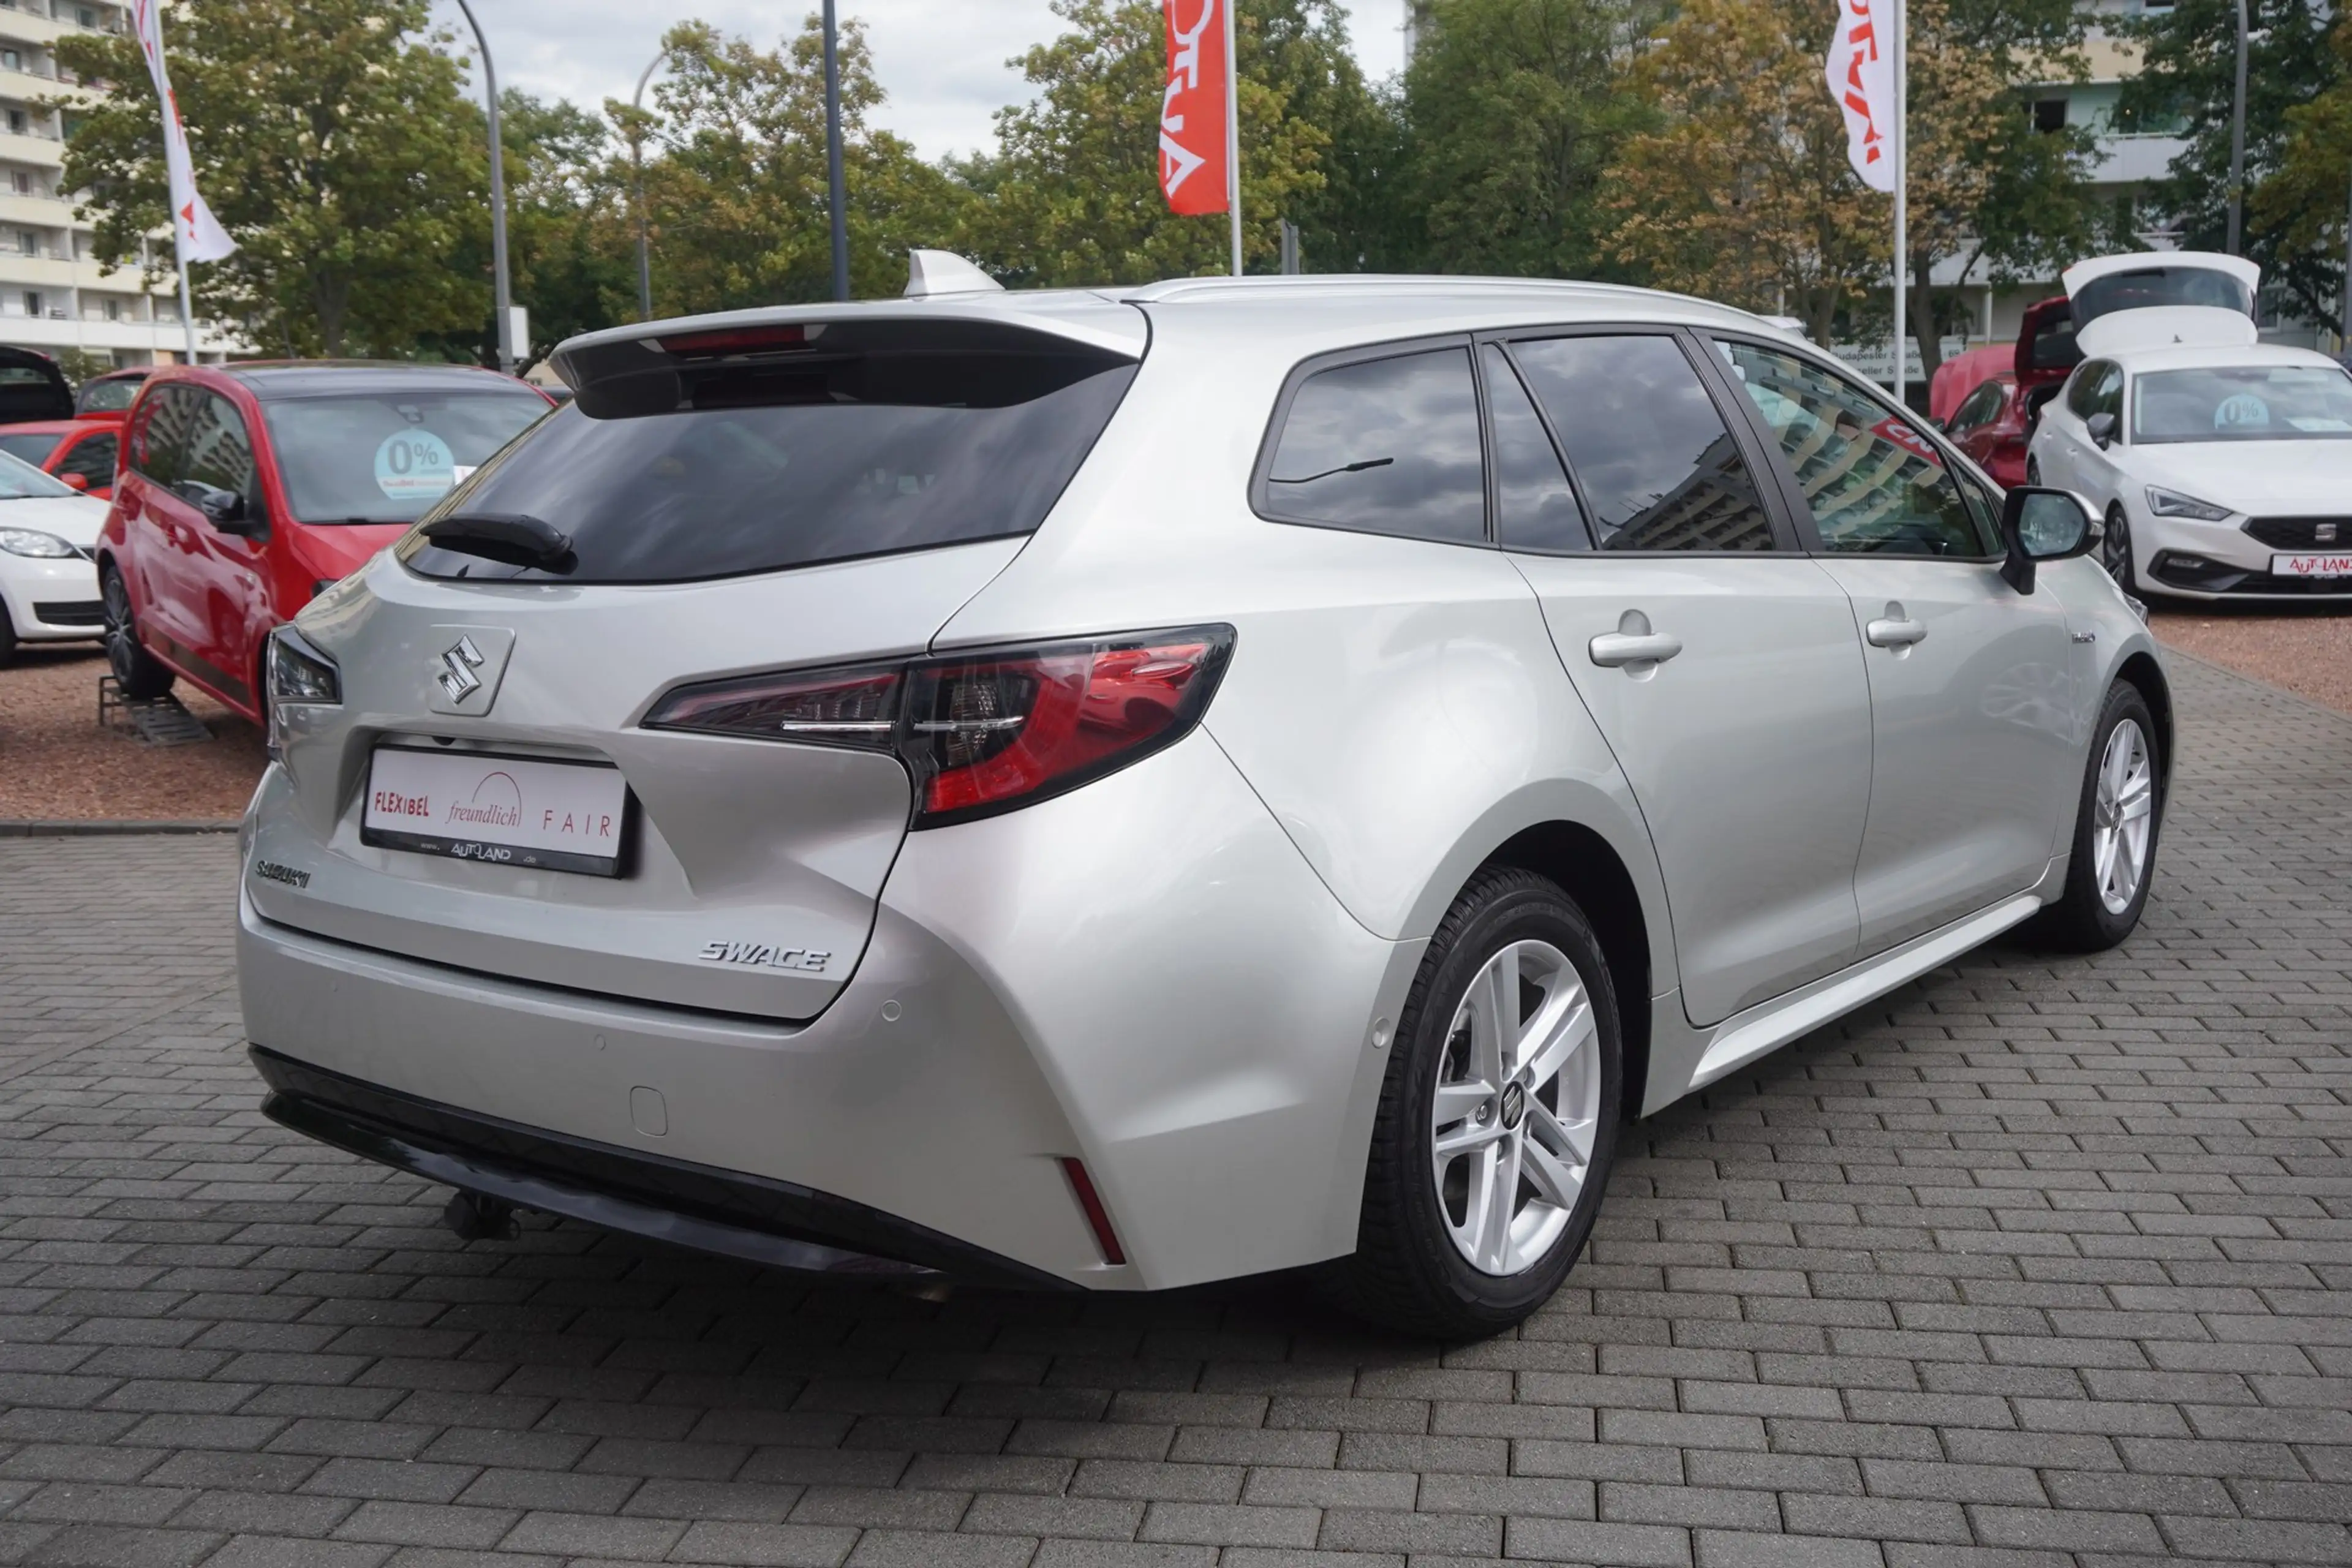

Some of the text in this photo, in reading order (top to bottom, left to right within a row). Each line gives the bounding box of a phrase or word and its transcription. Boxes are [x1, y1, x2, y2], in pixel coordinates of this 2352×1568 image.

[388, 439, 439, 475] 0%
[374, 791, 610, 837] FLEXIBEL freundlich FAIR
[451, 843, 512, 861] AUTOLAND
[698, 939, 832, 973] SWACE
